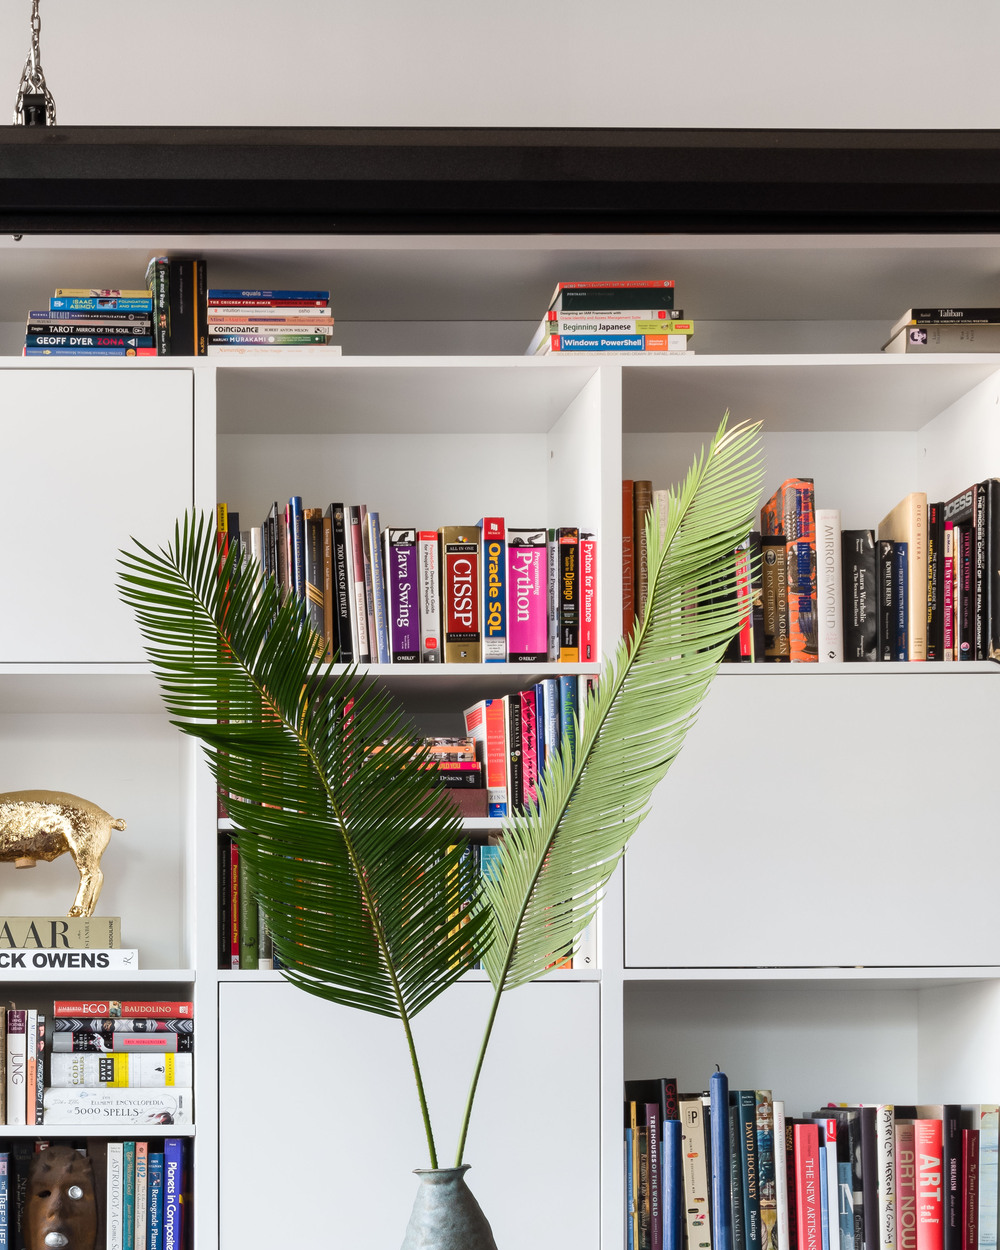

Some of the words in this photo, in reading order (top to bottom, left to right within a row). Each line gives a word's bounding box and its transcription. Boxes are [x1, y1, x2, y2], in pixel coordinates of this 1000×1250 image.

[563, 323, 598, 333] Beginning
[598, 323, 631, 332] Japanese
[938, 309, 964, 318] Taliban
[37, 337, 66, 345] GEOFF
[70, 337, 93, 346] DYER
[97, 338, 124, 346] ZONA
[395, 547, 411, 579] Java
[489, 543, 502, 597] Oracle
[583, 543, 593, 574] Python
[777, 548, 785, 566] THE
[453, 559, 472, 628] CISSP
[512, 551, 533, 622] Python
[563, 572, 575, 600] Django
[585, 575, 594, 586] for
[778, 568, 786, 599] HOUSE
[859, 569, 867, 590] Laura
[397, 582, 412, 627] Swing
[488, 602, 502, 635] SQL
[585, 589, 594, 622] Finance
[779, 600, 786, 612] OF
[859, 591, 867, 623] Warholic
[779, 614, 787, 655] MORGAN
[32, 952, 110, 969] OWENS
[10, 1051, 23, 1085] JUNG
[74, 1107, 101, 1115] 5000
[103, 1108, 139, 1117] SPELLS
[650, 1115, 658, 1162] TREEHOUSES
[746, 1122, 755, 1151] DAVID
[883, 1109, 894, 1158] PATRICK
[137, 1156, 146, 1178] 1492
[167, 1162, 178, 1193] Planets
[651, 1163, 658, 1173] OF
[651, 1174, 659, 1190] THE
[747, 1153, 757, 1200] HOCKNEY
[805, 1158, 814, 1180] THE
[884, 1161, 893, 1195] HERON
[900, 1150, 915, 1191] ART
[919, 1153, 941, 1202] ART
[168, 1195, 178, 1203] in
[806, 1180, 815, 1203] NEW
[150, 1189, 159, 1227] Retrograde
[901, 1196, 916, 1249] NOW
[750, 1210, 758, 1241] Paintings
